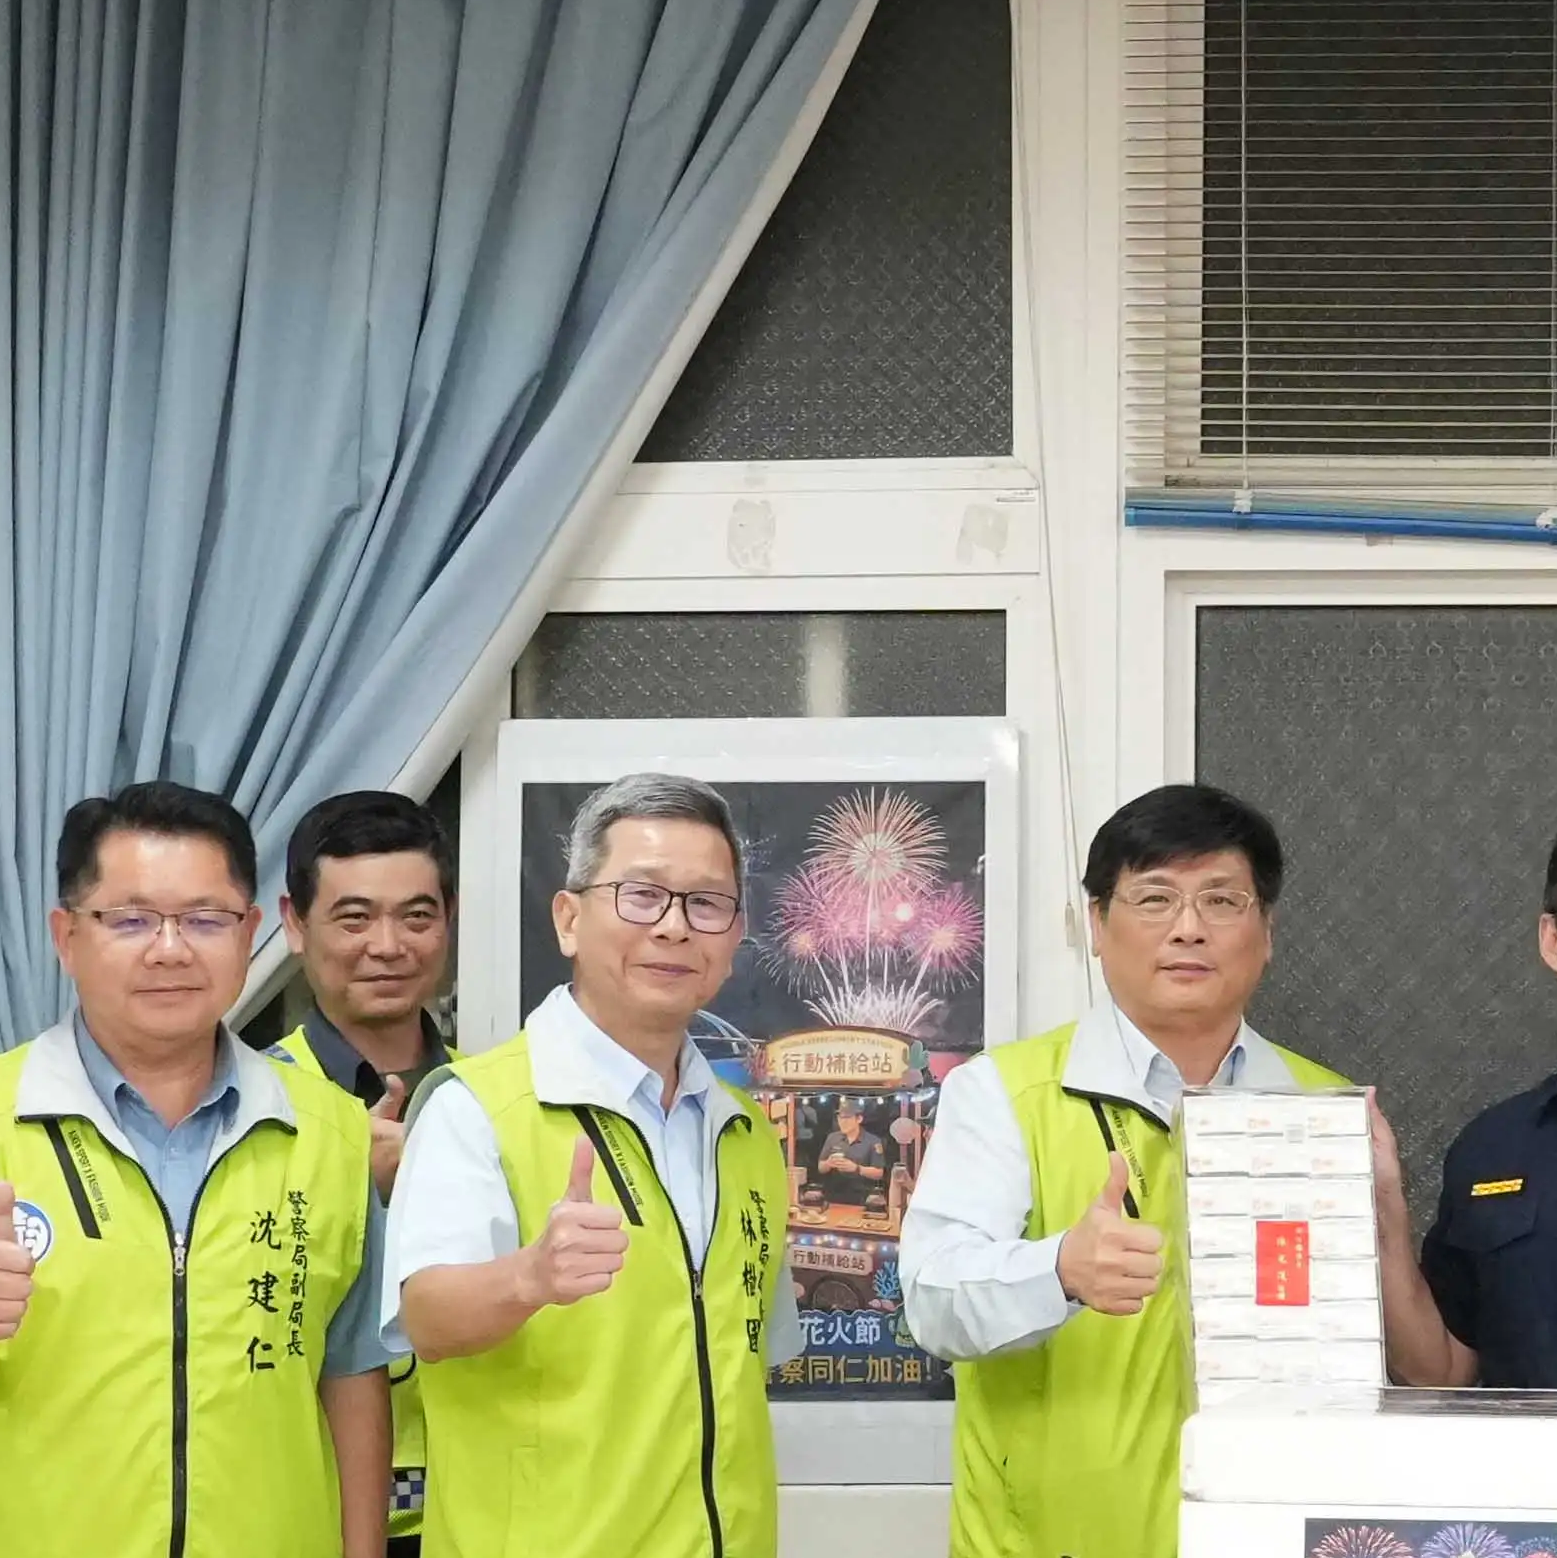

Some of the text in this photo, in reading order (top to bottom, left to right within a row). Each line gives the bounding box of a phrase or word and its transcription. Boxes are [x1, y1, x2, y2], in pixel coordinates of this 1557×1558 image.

[783, 1053, 893, 1074] 行動補給站
[793, 1249, 865, 1270] 行動補給站
[246, 1210, 282, 1373] 沈建仁
[801, 1313, 881, 1345] 花火節
[767, 1355, 932, 1386] 察同仁加油!
